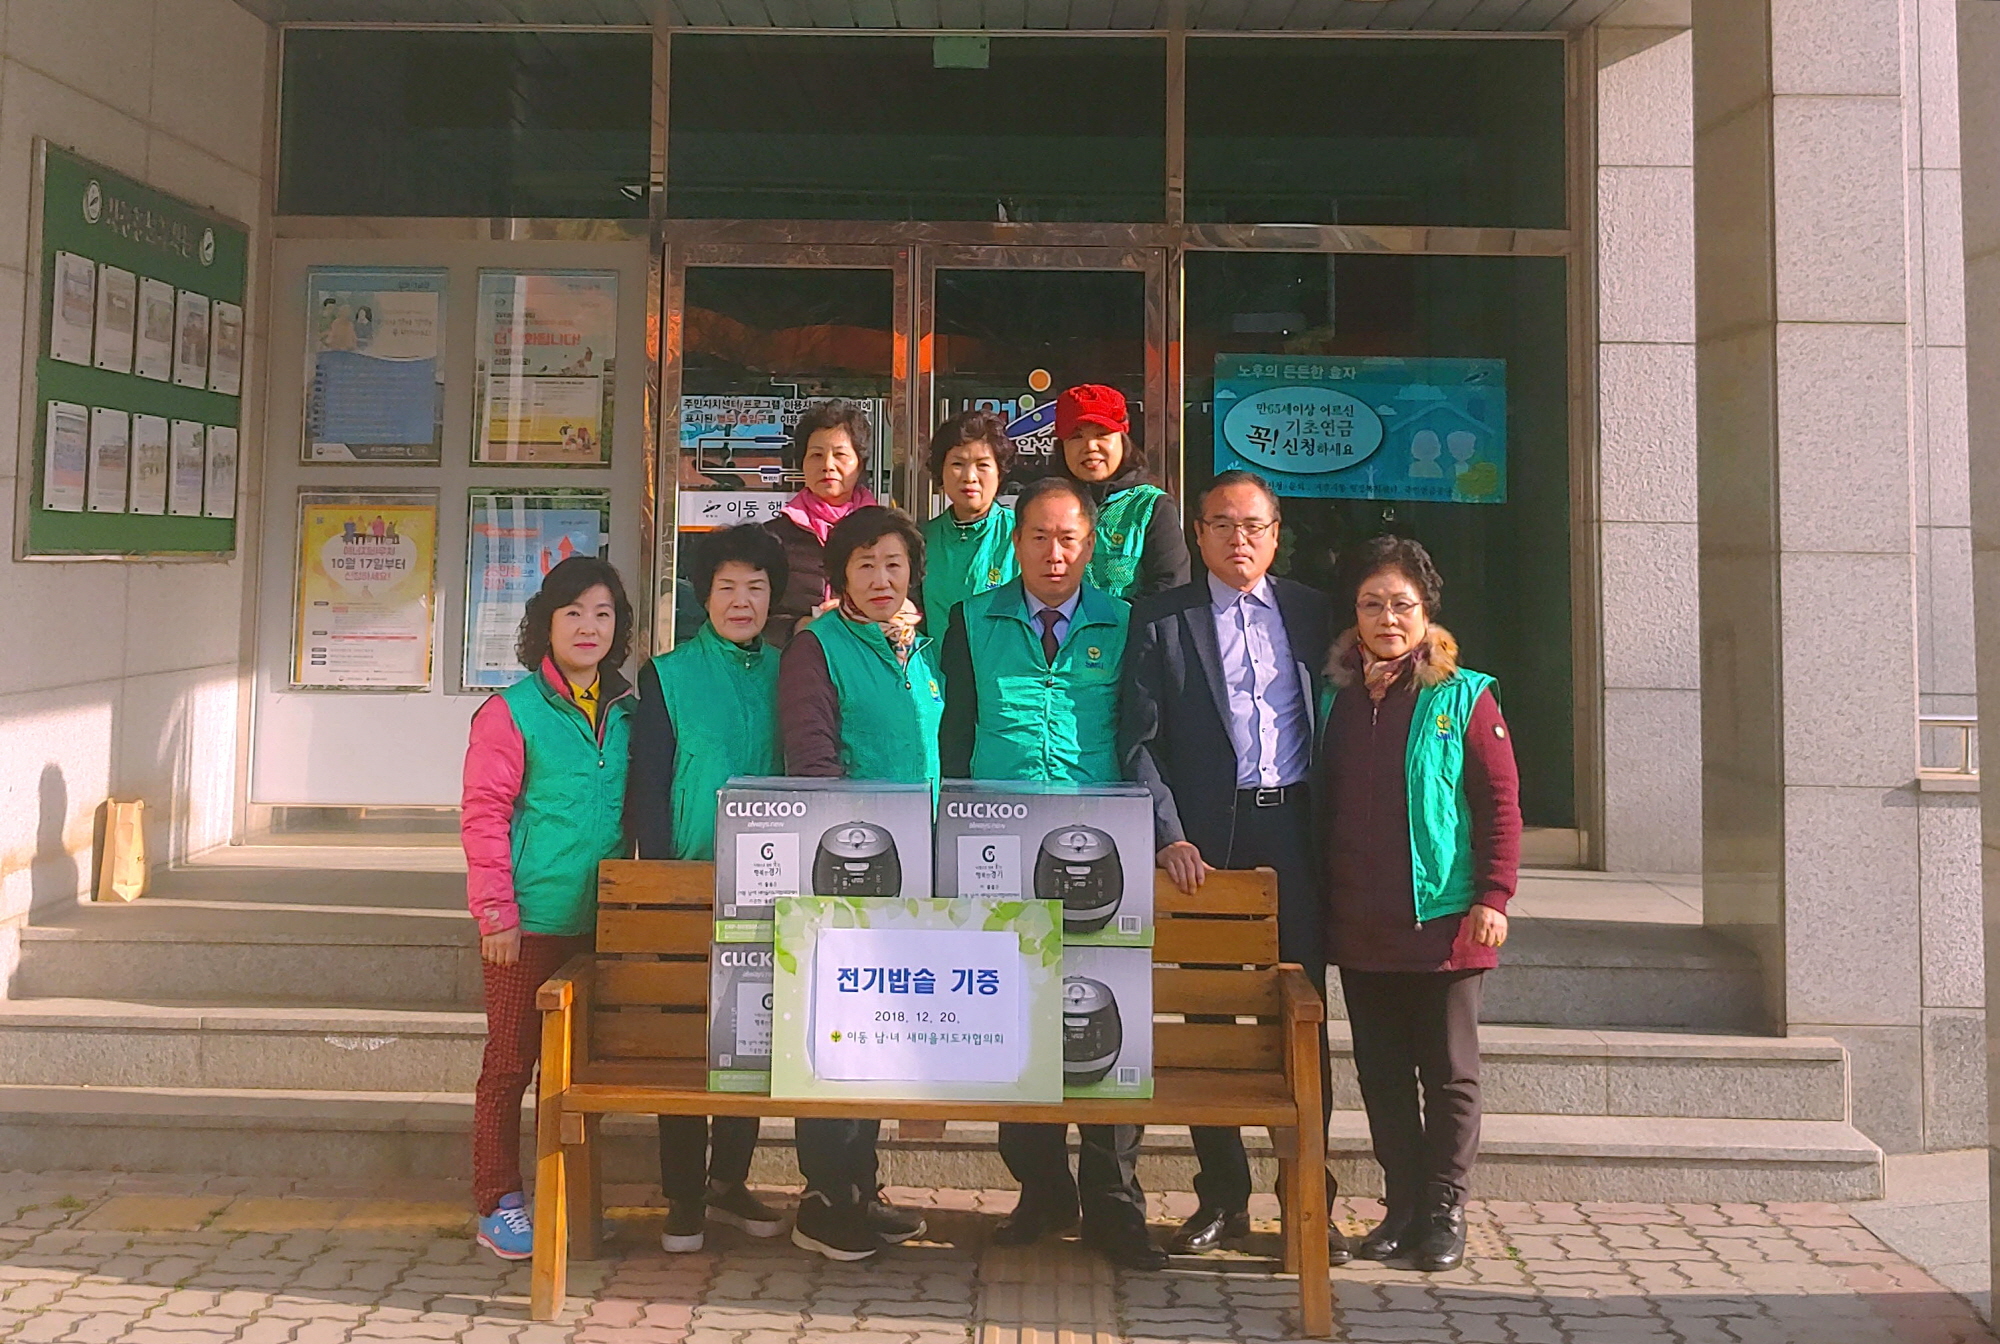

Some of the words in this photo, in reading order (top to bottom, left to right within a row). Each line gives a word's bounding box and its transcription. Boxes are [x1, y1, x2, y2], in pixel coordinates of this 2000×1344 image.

[1238, 364, 1277, 378] 노후의
[1283, 364, 1324, 379] 든든한
[1328, 366, 1356, 380] 효자
[743, 399, 780, 410] 프로그램
[784, 399, 819, 410] 이용자
[1256, 402, 1315, 417] 만65세이상
[1319, 404, 1354, 418] 어르신
[685, 414, 713, 424] 표시된
[780, 415, 798, 425] 이용
[1285, 419, 1354, 438] 기초연금
[1246, 424, 1279, 455] 꼭!
[1282, 438, 1354, 457] 신청하세요
[726, 500, 759, 518] 이동
[767, 500, 789, 518] 행
[331, 558, 355, 570] 10월
[360, 558, 406, 570] 17일부터
[344, 572, 391, 581] 신청하세요!
[725, 801, 807, 817] CUCKOO
[947, 802, 1028, 819] CUCKOO
[720, 951, 773, 967] CUCK
[836, 967, 937, 995] 전기밥솥
[950, 968, 1000, 995] 기증
[875, 1011, 909, 1023] 2018.
[916, 1012, 933, 1024] 12.
[940, 1012, 961, 1024] 20.
[847, 1031, 868, 1044] 이동
[907, 1032, 1004, 1045] 새마을지도자협의회
